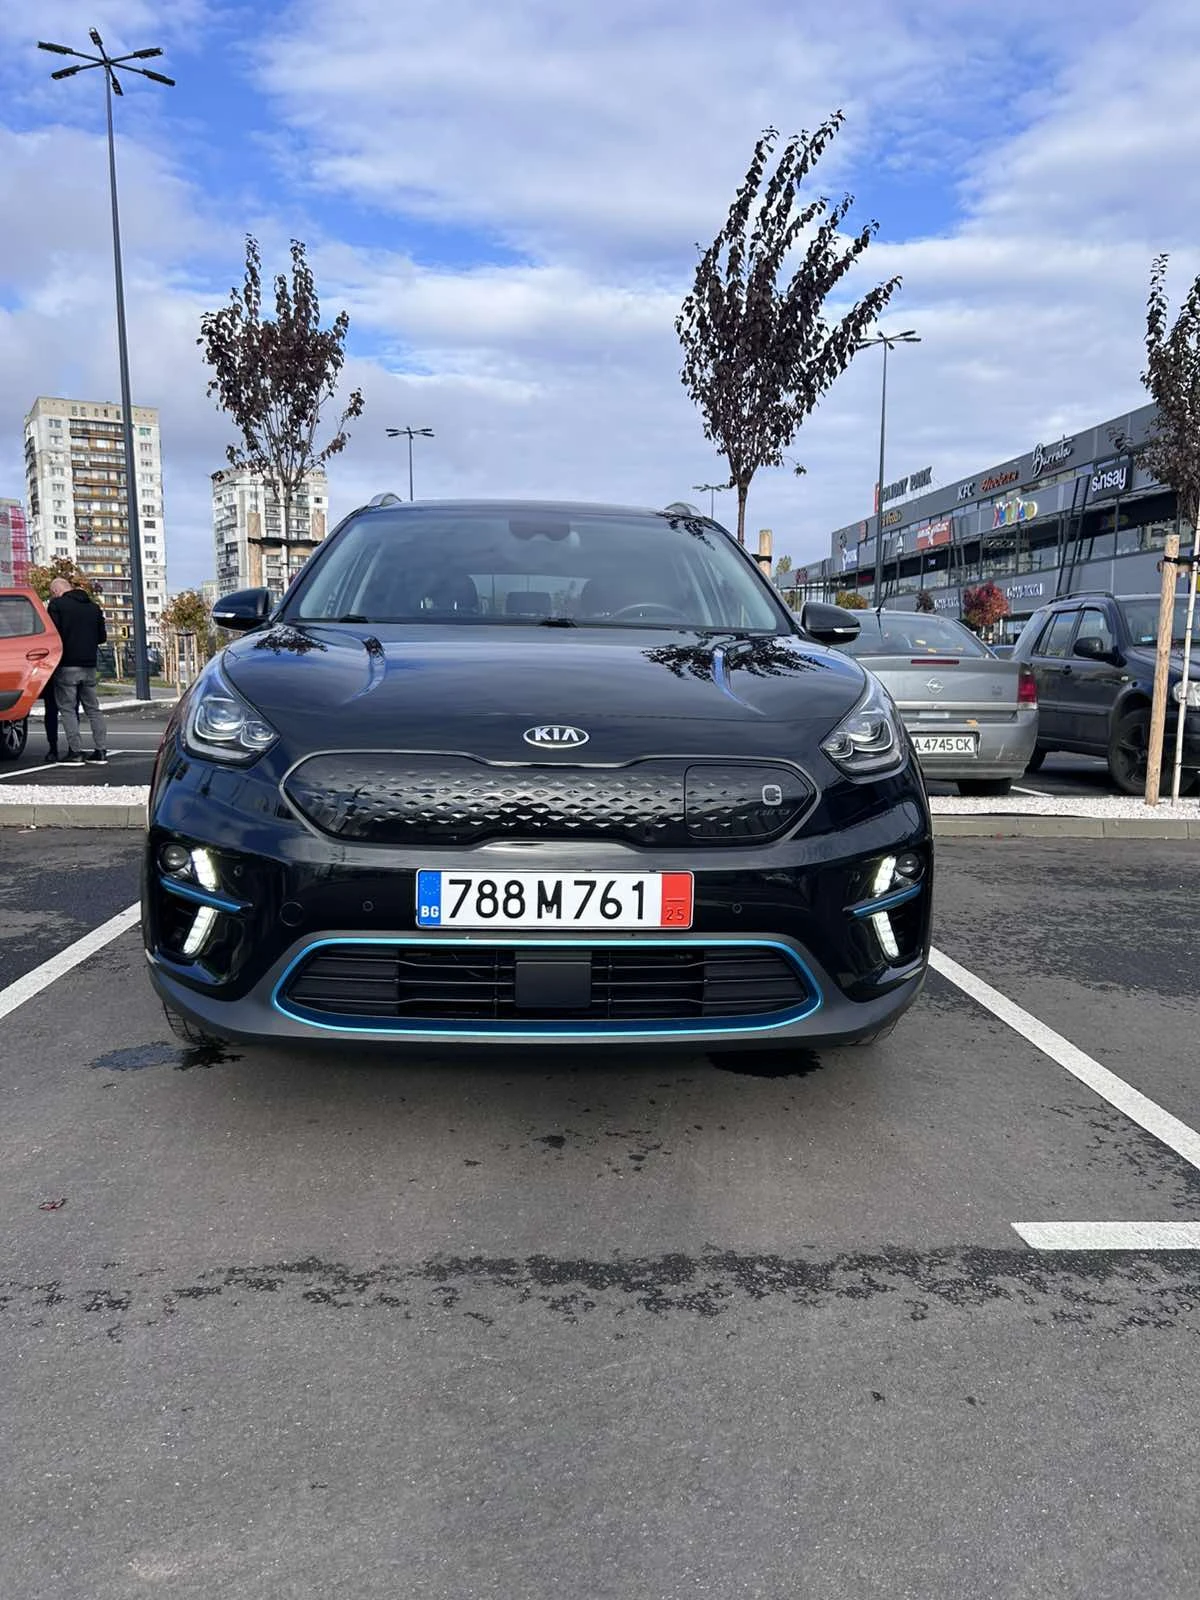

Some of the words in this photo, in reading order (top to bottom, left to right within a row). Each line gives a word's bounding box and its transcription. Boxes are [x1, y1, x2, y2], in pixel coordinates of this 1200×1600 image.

[1032, 434, 1074, 479] Burrata
[910, 466, 932, 491] PARK
[957, 482, 975, 500] KFC
[1091, 467, 1127, 492] sinsay
[534, 727, 580, 742] KIA
[924, 739, 954, 751] 4745
[956, 739, 972, 751] CK
[421, 906, 440, 918] BG
[448, 879, 526, 919] 788
[537, 880, 563, 919] M
[573, 880, 645, 920] 761
[666, 907, 685, 921] 25
